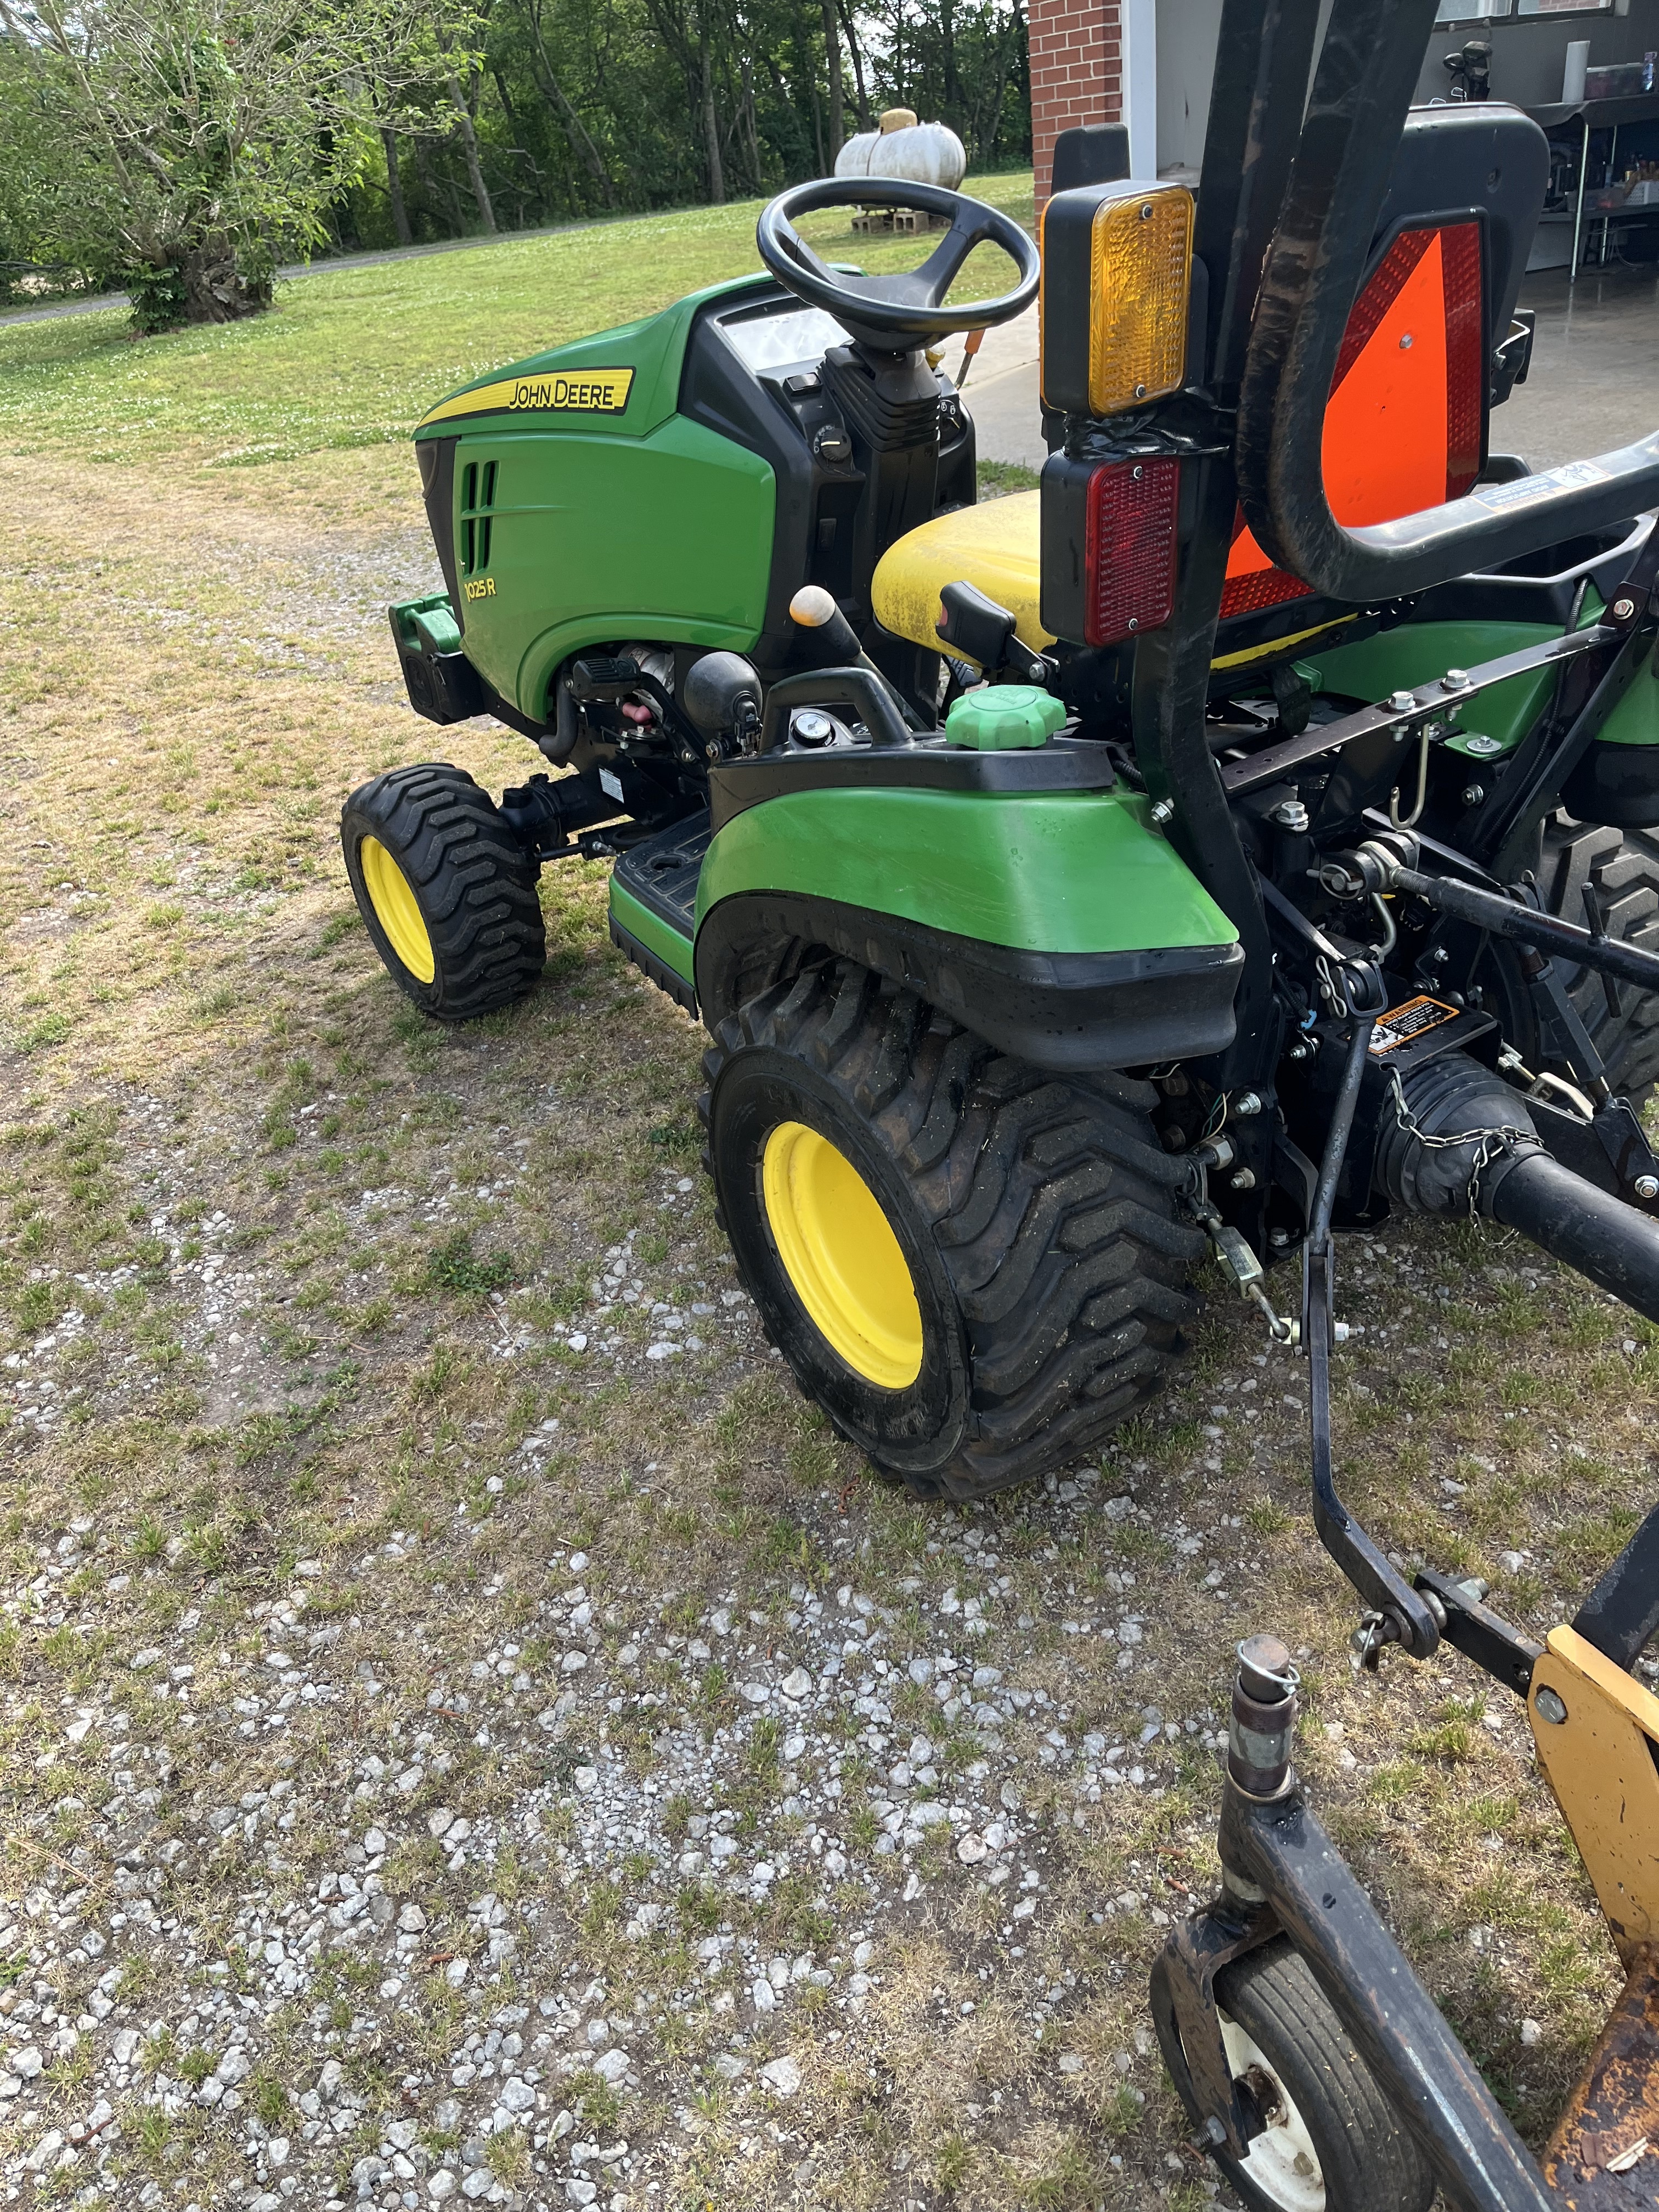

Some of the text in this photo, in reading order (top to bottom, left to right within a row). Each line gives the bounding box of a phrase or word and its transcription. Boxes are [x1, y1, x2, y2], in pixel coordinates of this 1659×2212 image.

[509, 380, 615, 409] JOHN DEERE
[1389, 999, 1424, 1018] WARNING
